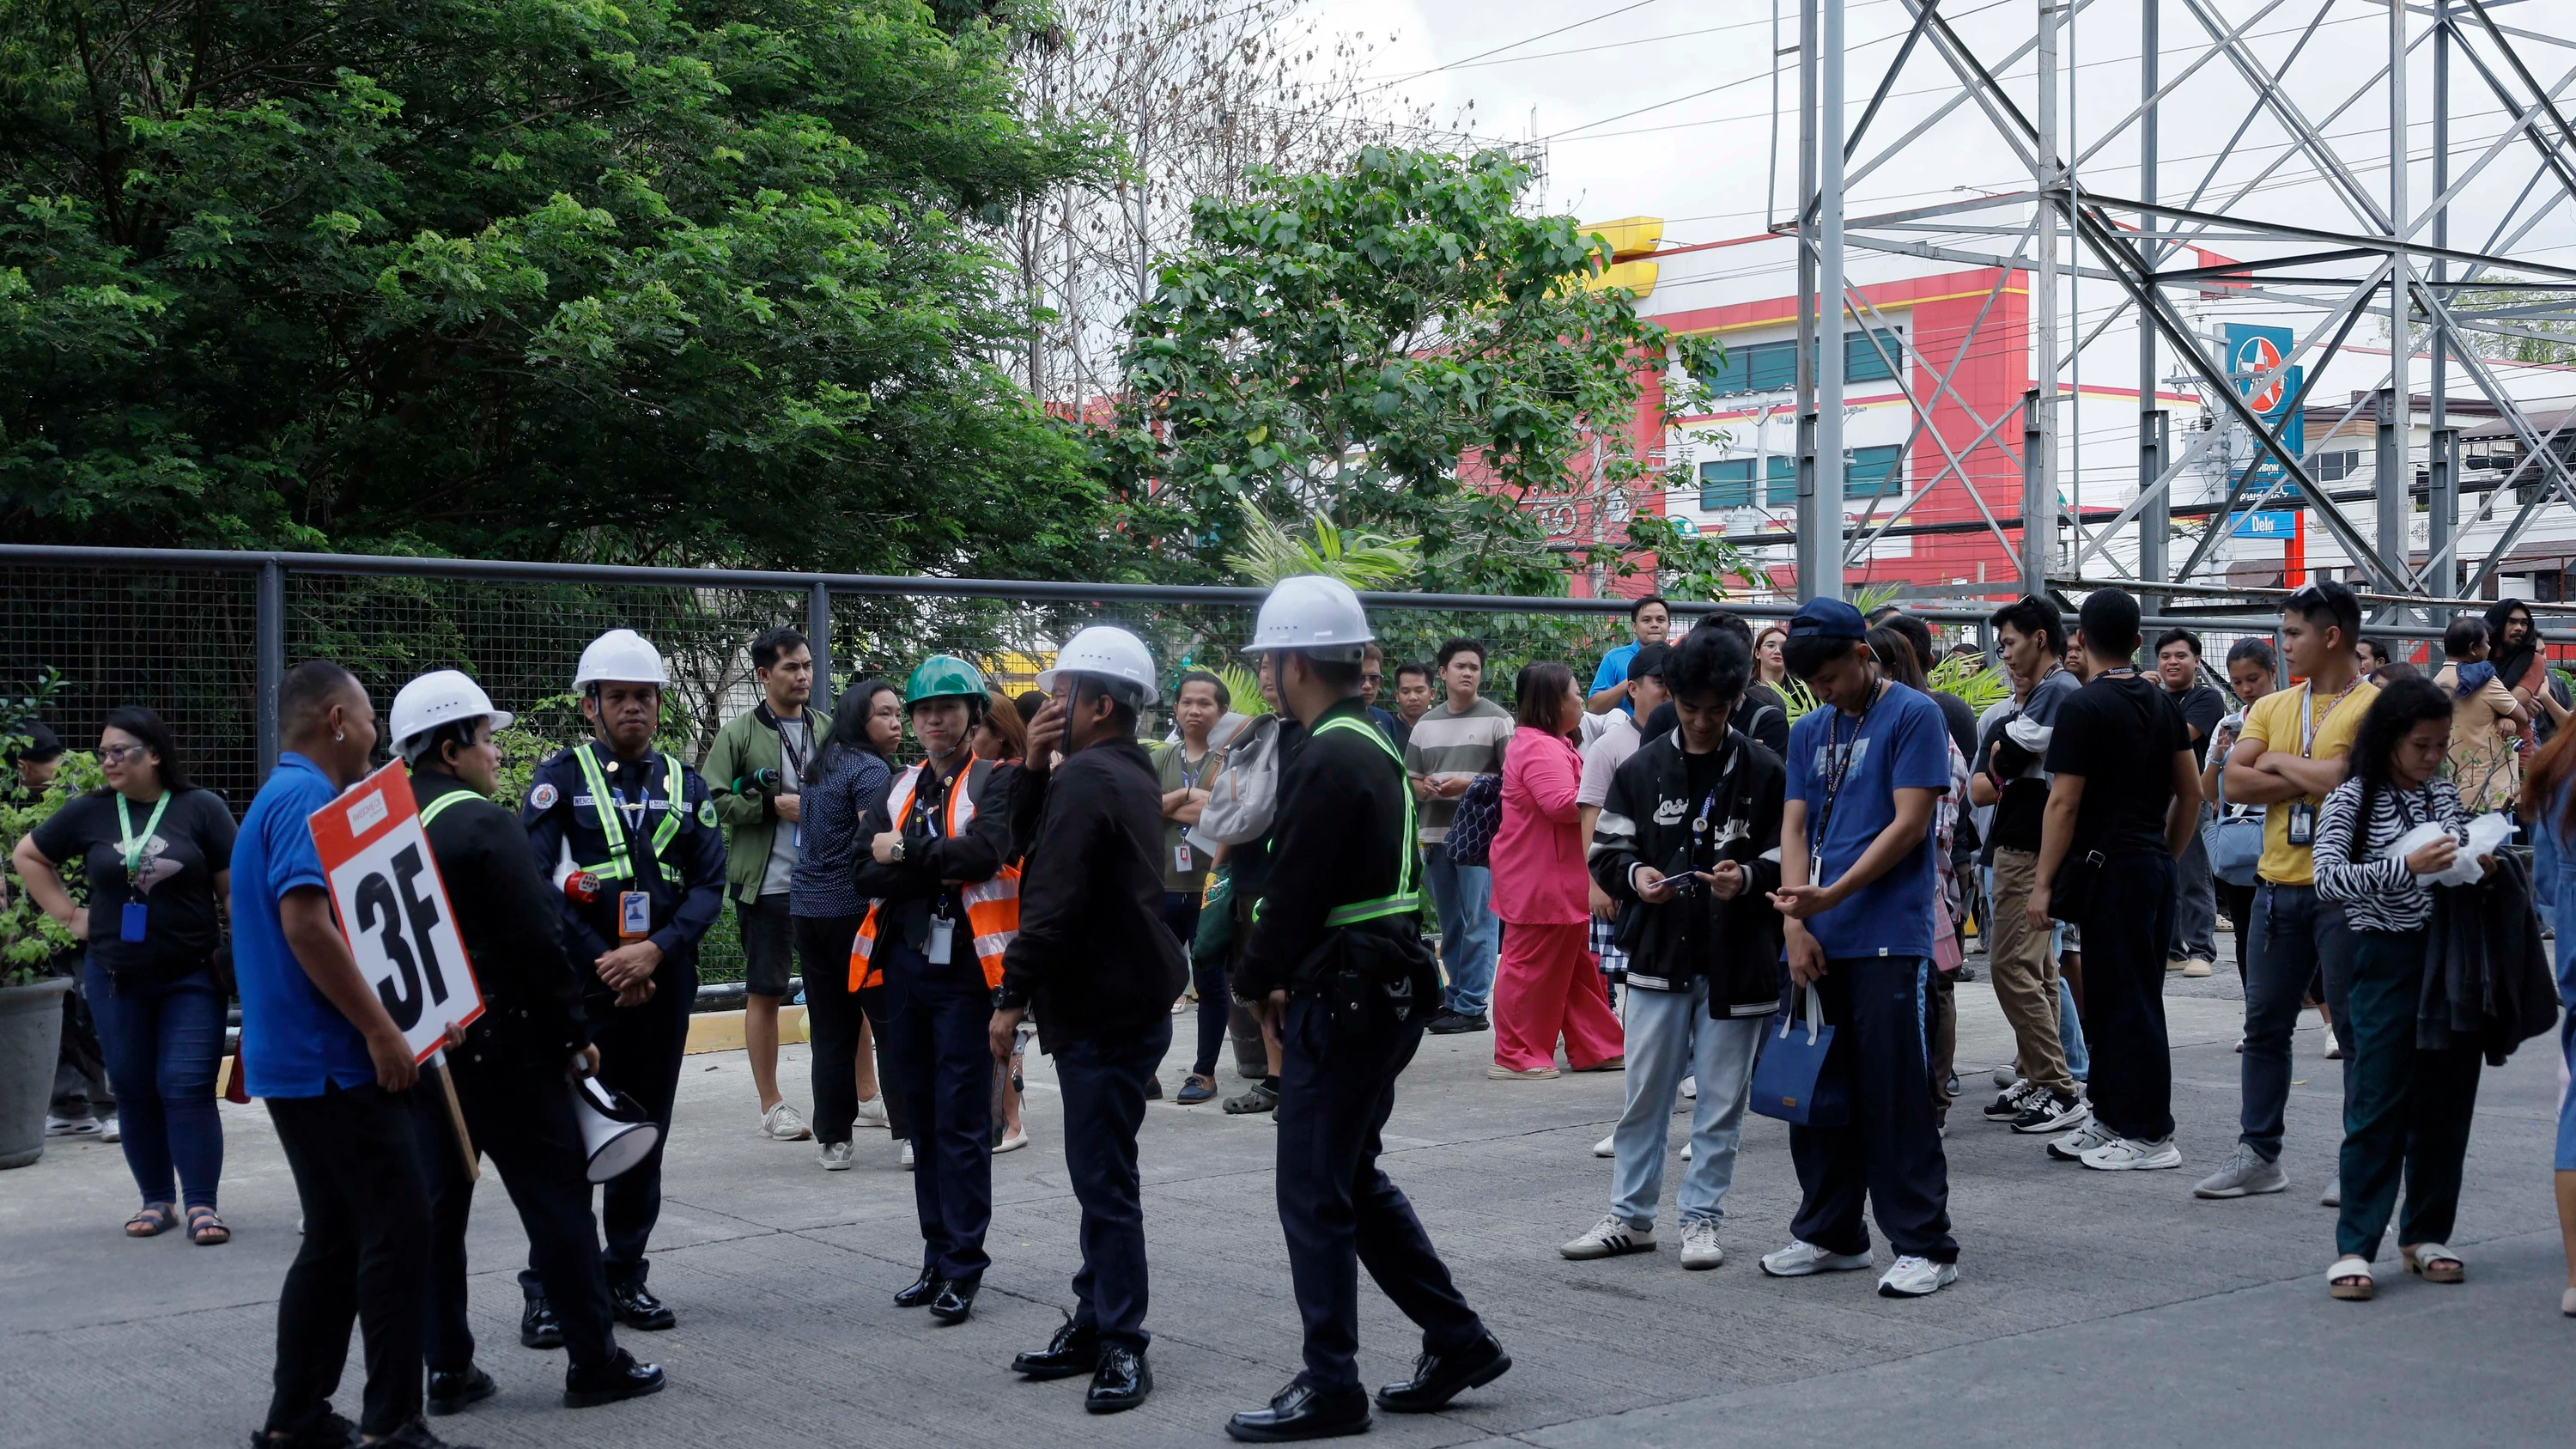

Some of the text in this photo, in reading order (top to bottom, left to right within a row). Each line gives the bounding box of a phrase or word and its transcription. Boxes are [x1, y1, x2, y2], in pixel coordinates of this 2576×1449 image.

[2251, 515, 2274, 533] Delo
[1866, 683, 1880, 709] COMCAST
[776, 722, 788, 741] COMCAST
[1847, 723, 1861, 750] COMCAST
[1832, 764, 1844, 792] COMCAST
[574, 797, 596, 806] WENCE
[355, 842, 448, 1032] 3F
